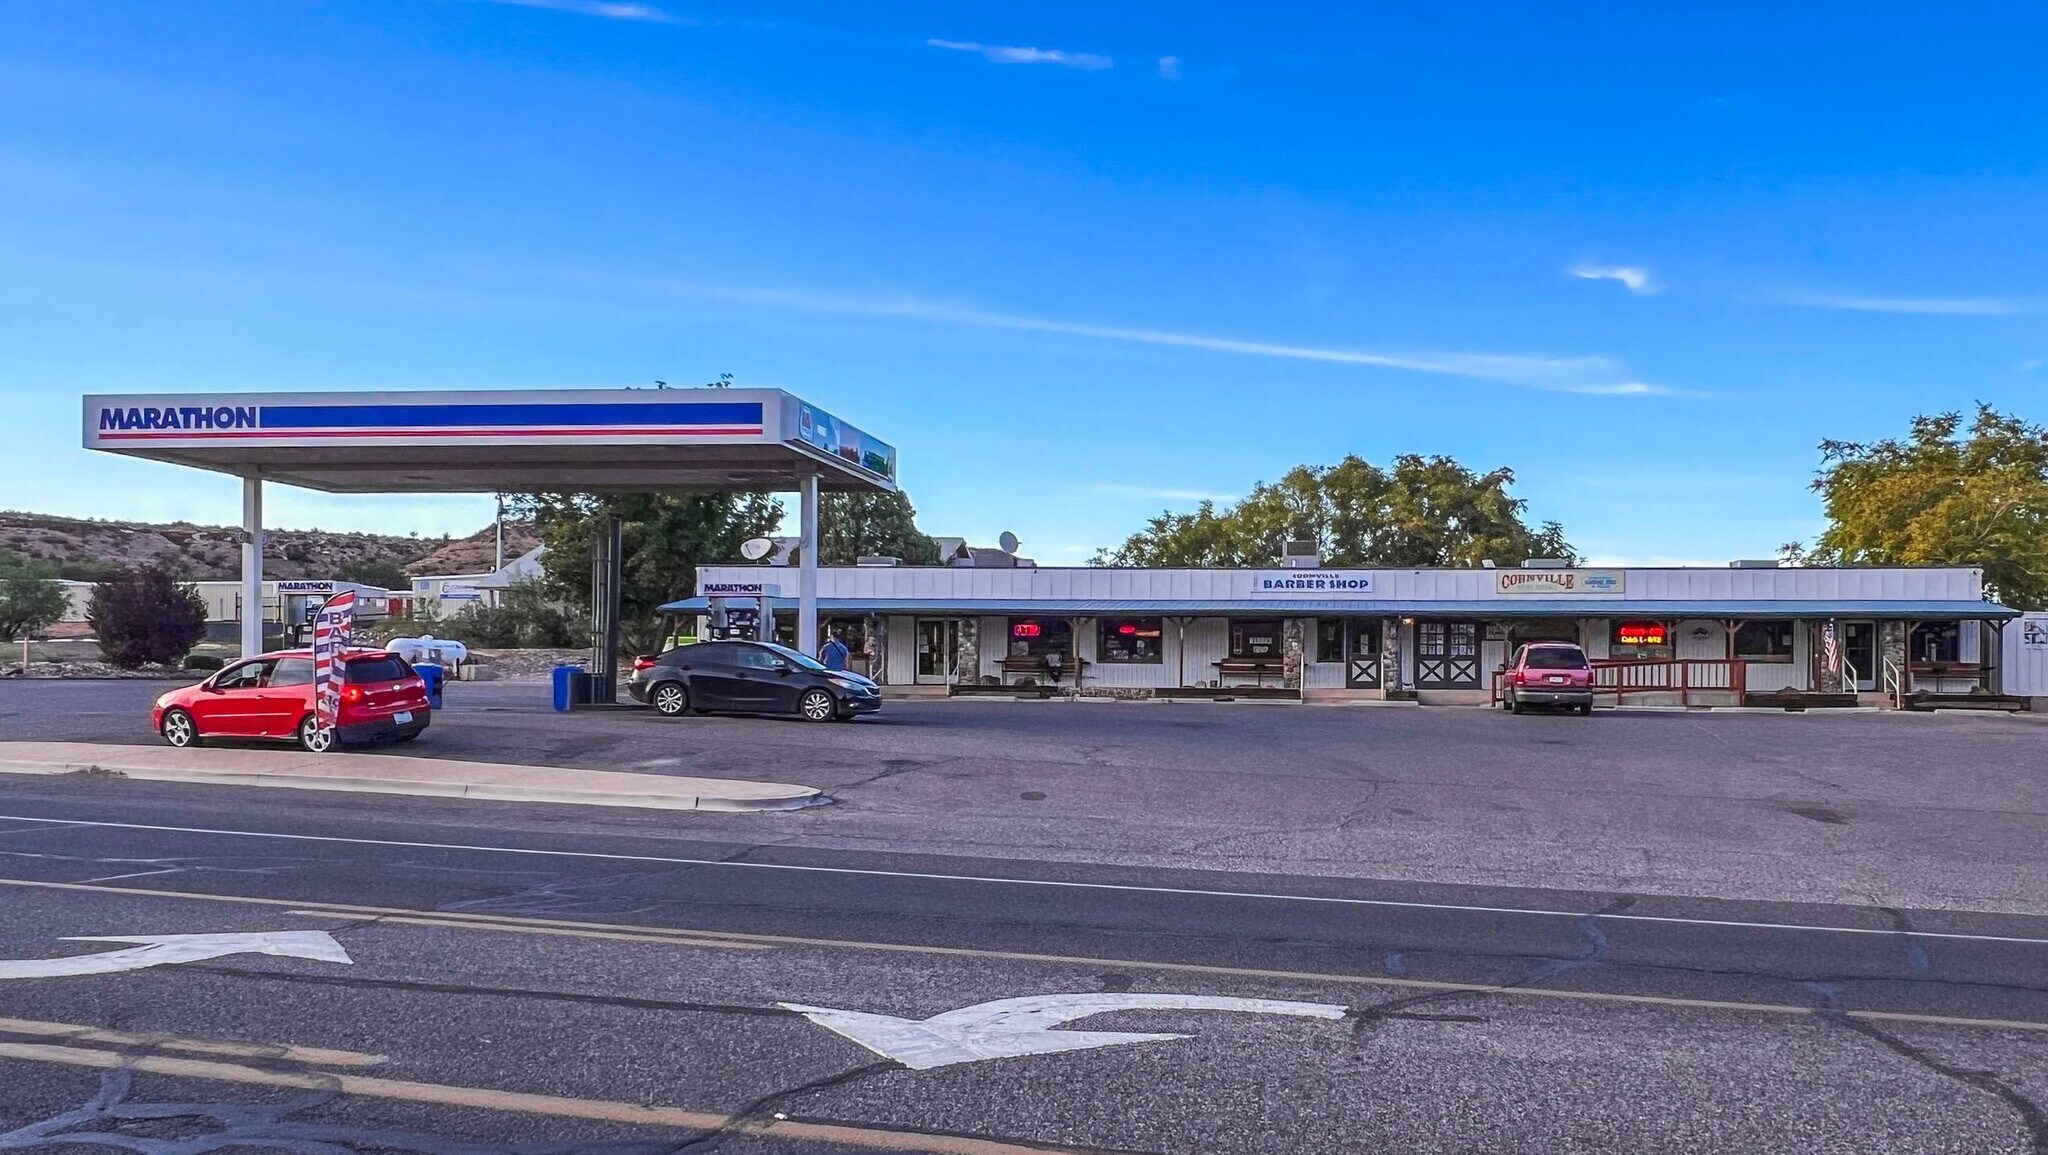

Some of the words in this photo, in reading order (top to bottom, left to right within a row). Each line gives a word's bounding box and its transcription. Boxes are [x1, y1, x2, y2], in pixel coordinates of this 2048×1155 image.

[99, 407, 256, 429] MARATHON
[279, 582, 333, 590] MARATHON
[1263, 579, 1326, 589] BARBER
[1329, 579, 1369, 589] SHOP
[1501, 574, 1574, 589] CORNVILLE
[704, 584, 762, 592] MARATHON
